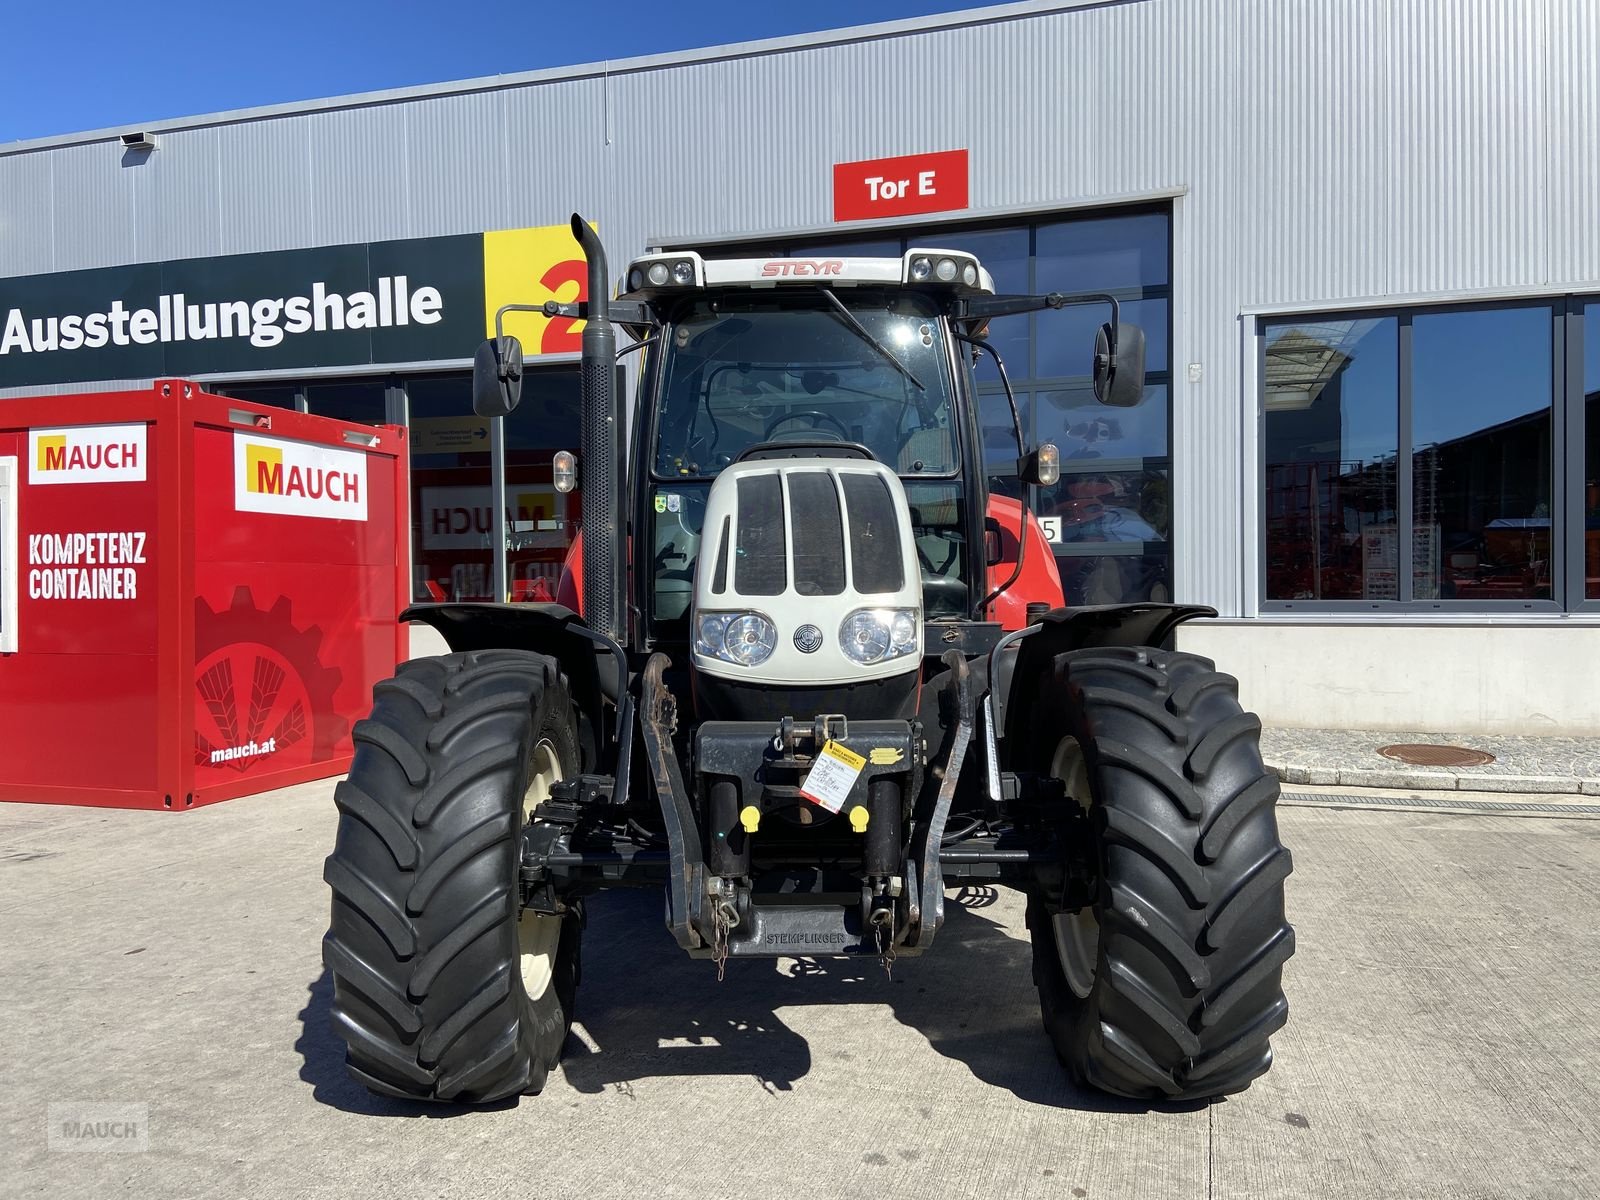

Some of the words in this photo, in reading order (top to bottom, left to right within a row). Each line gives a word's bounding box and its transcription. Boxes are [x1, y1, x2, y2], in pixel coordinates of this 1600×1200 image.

[864, 176, 910, 201] Tor
[918, 170, 937, 196] E
[761, 260, 844, 277] STEYR
[0, 275, 443, 355] Ausstellungshalle
[539, 259, 589, 354] 2
[46, 443, 138, 471] MAUCH
[257, 460, 360, 503] MAUCH
[1043, 520, 1056, 541] 5
[29, 532, 147, 565] KOMPETENZ
[29, 567, 138, 600] CONTAINER
[211, 737, 276, 763] mauch.at
[766, 933, 845, 944] STEMPLINGER
